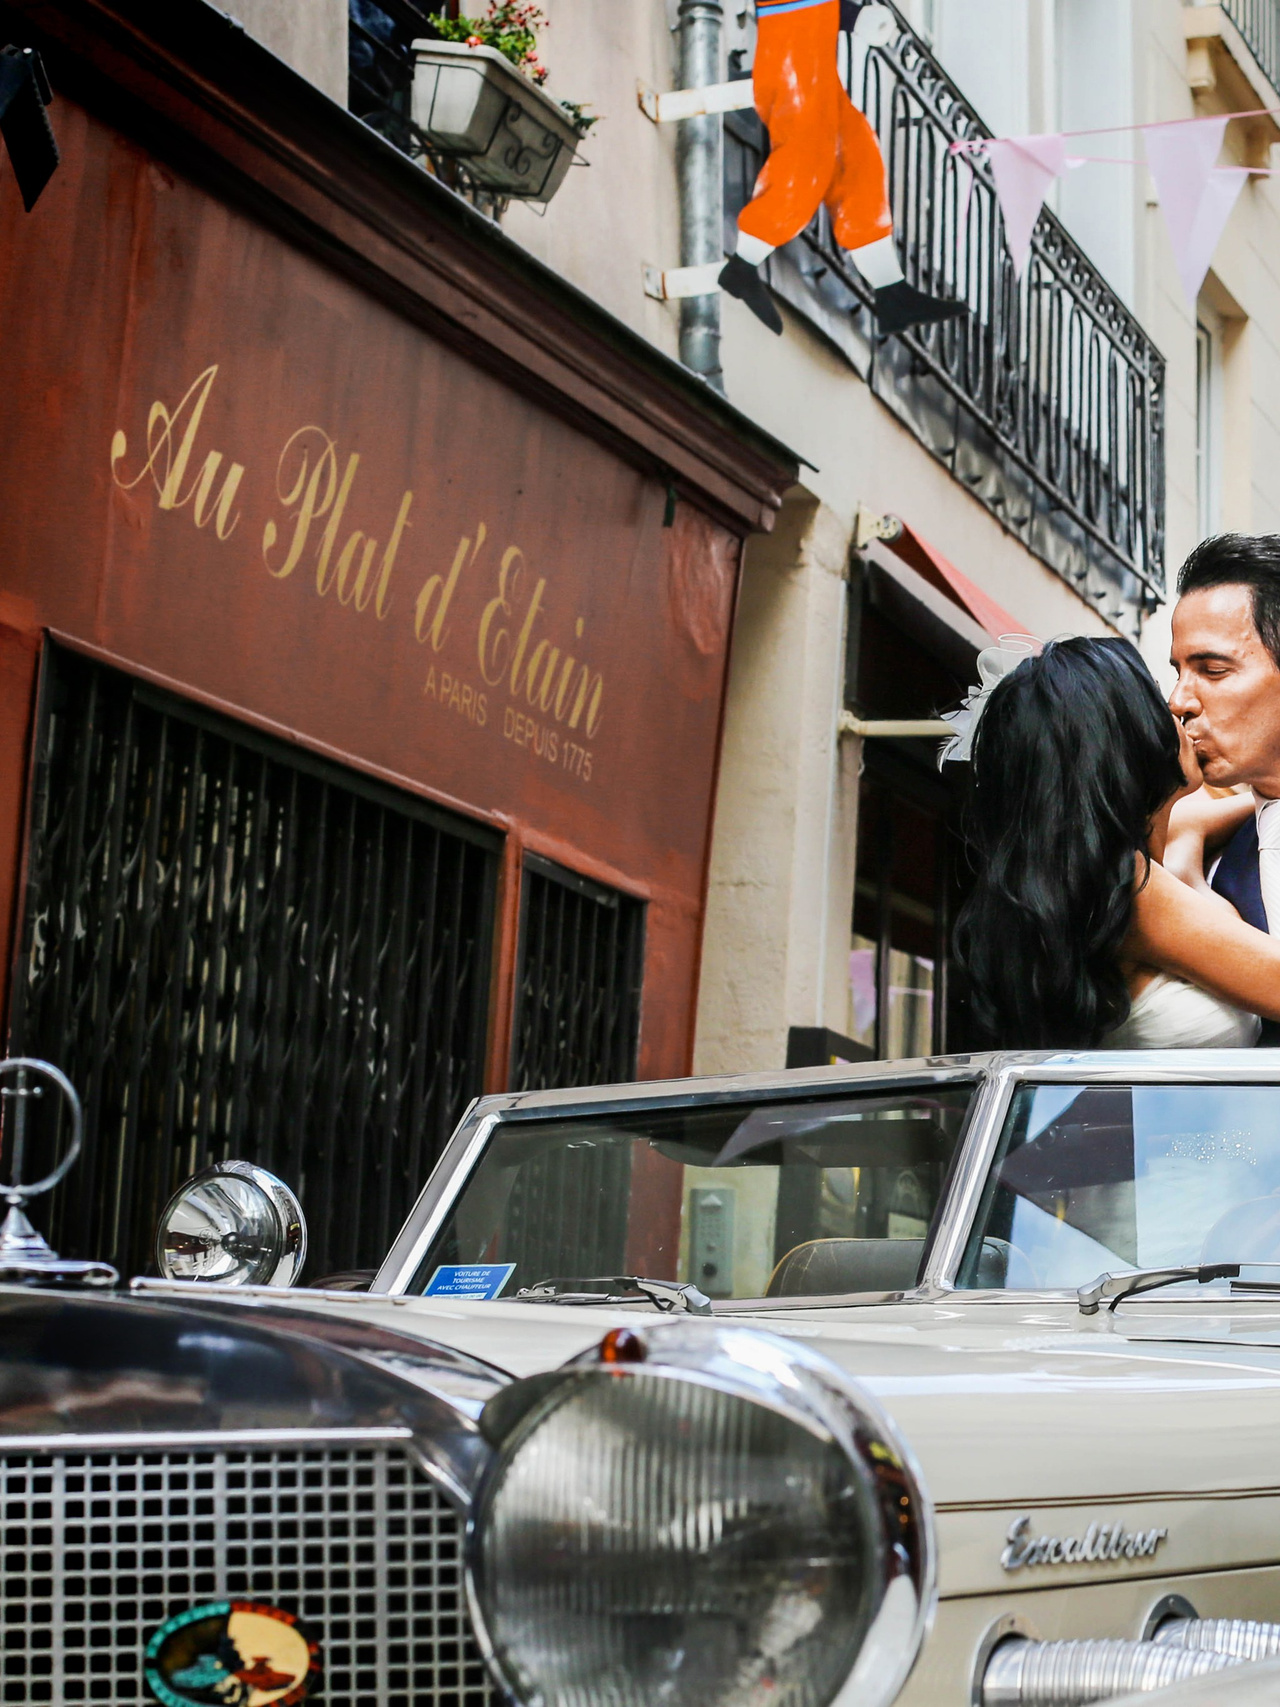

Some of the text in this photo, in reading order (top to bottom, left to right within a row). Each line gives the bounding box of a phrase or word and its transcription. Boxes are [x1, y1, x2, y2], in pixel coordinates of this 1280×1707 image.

[111, 364, 603, 740] Au Plat d' Etain
[424, 664, 594, 782] A PARIS DEPUIS 1775
[1000, 1514, 1169, 1571] Excalibur
